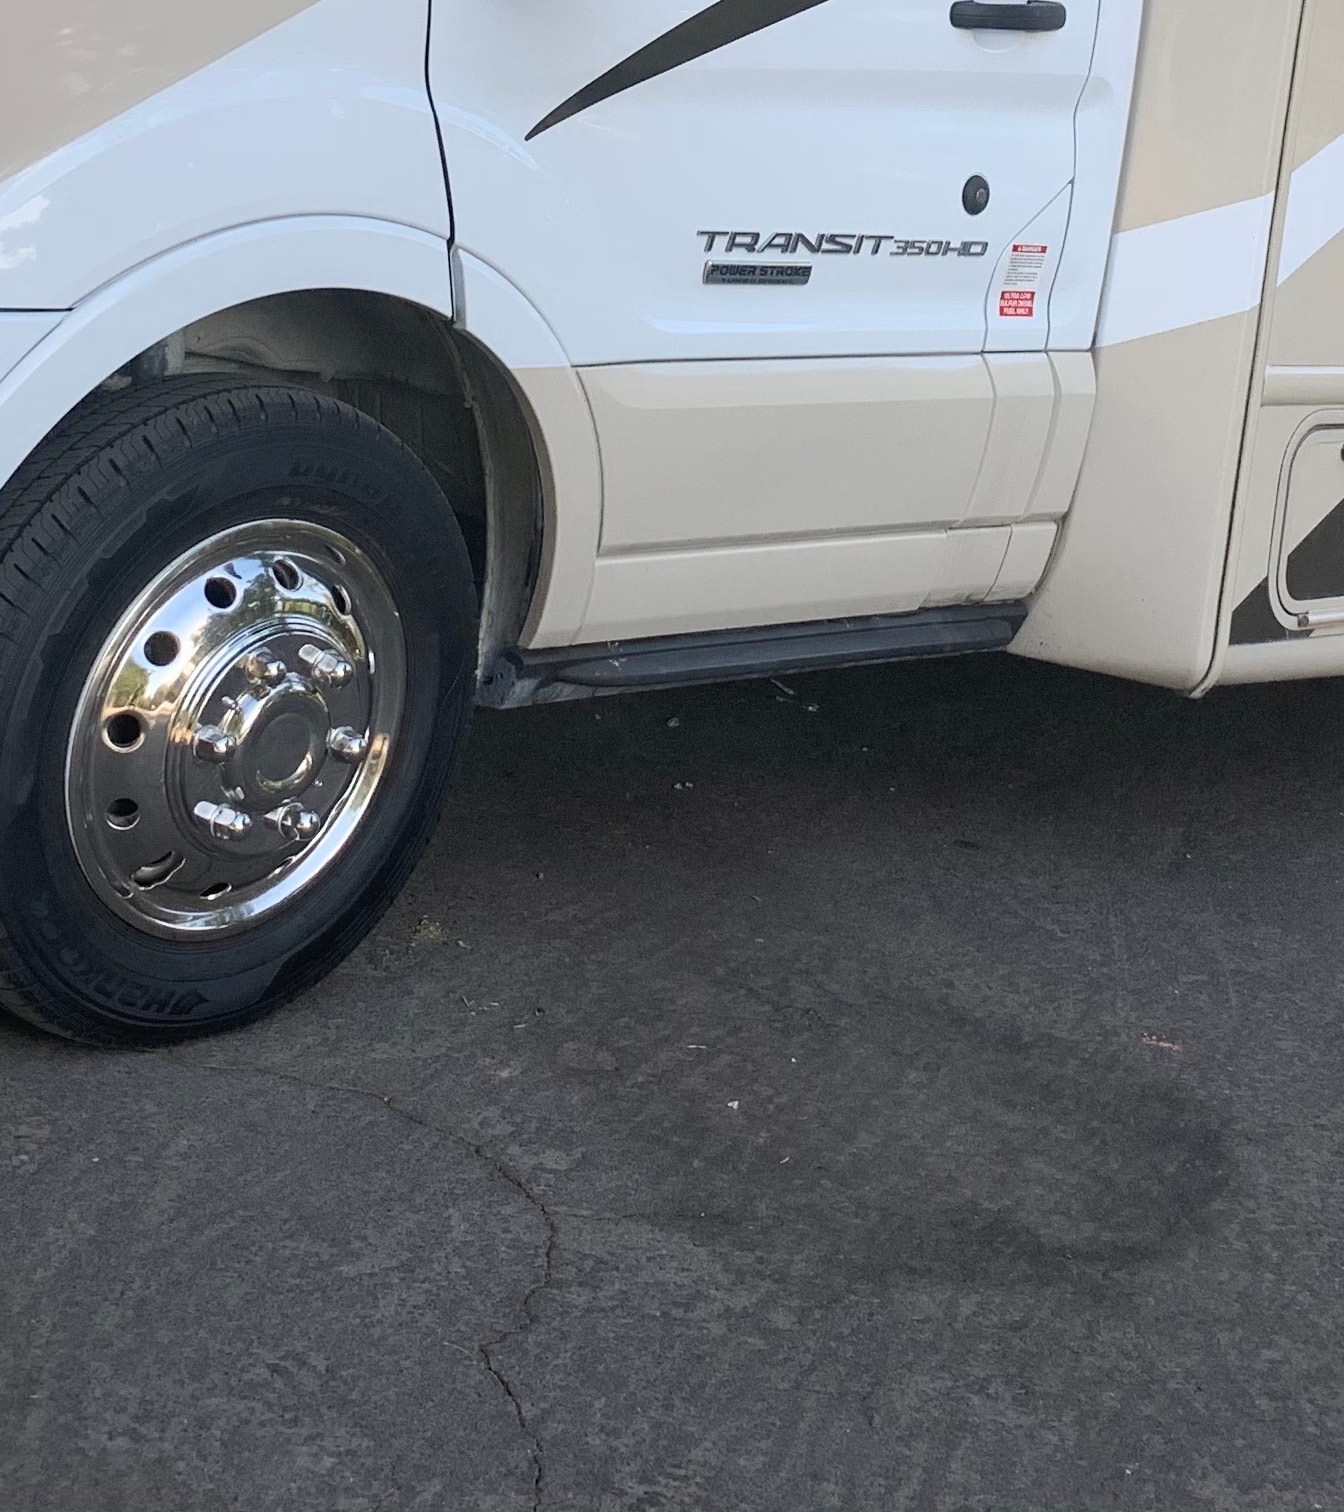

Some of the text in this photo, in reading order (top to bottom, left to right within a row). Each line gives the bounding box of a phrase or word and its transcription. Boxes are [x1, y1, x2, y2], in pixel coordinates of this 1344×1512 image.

[697, 230, 988, 256] TRANSIT 350HD
[711, 264, 812, 278] POWER STROKE
